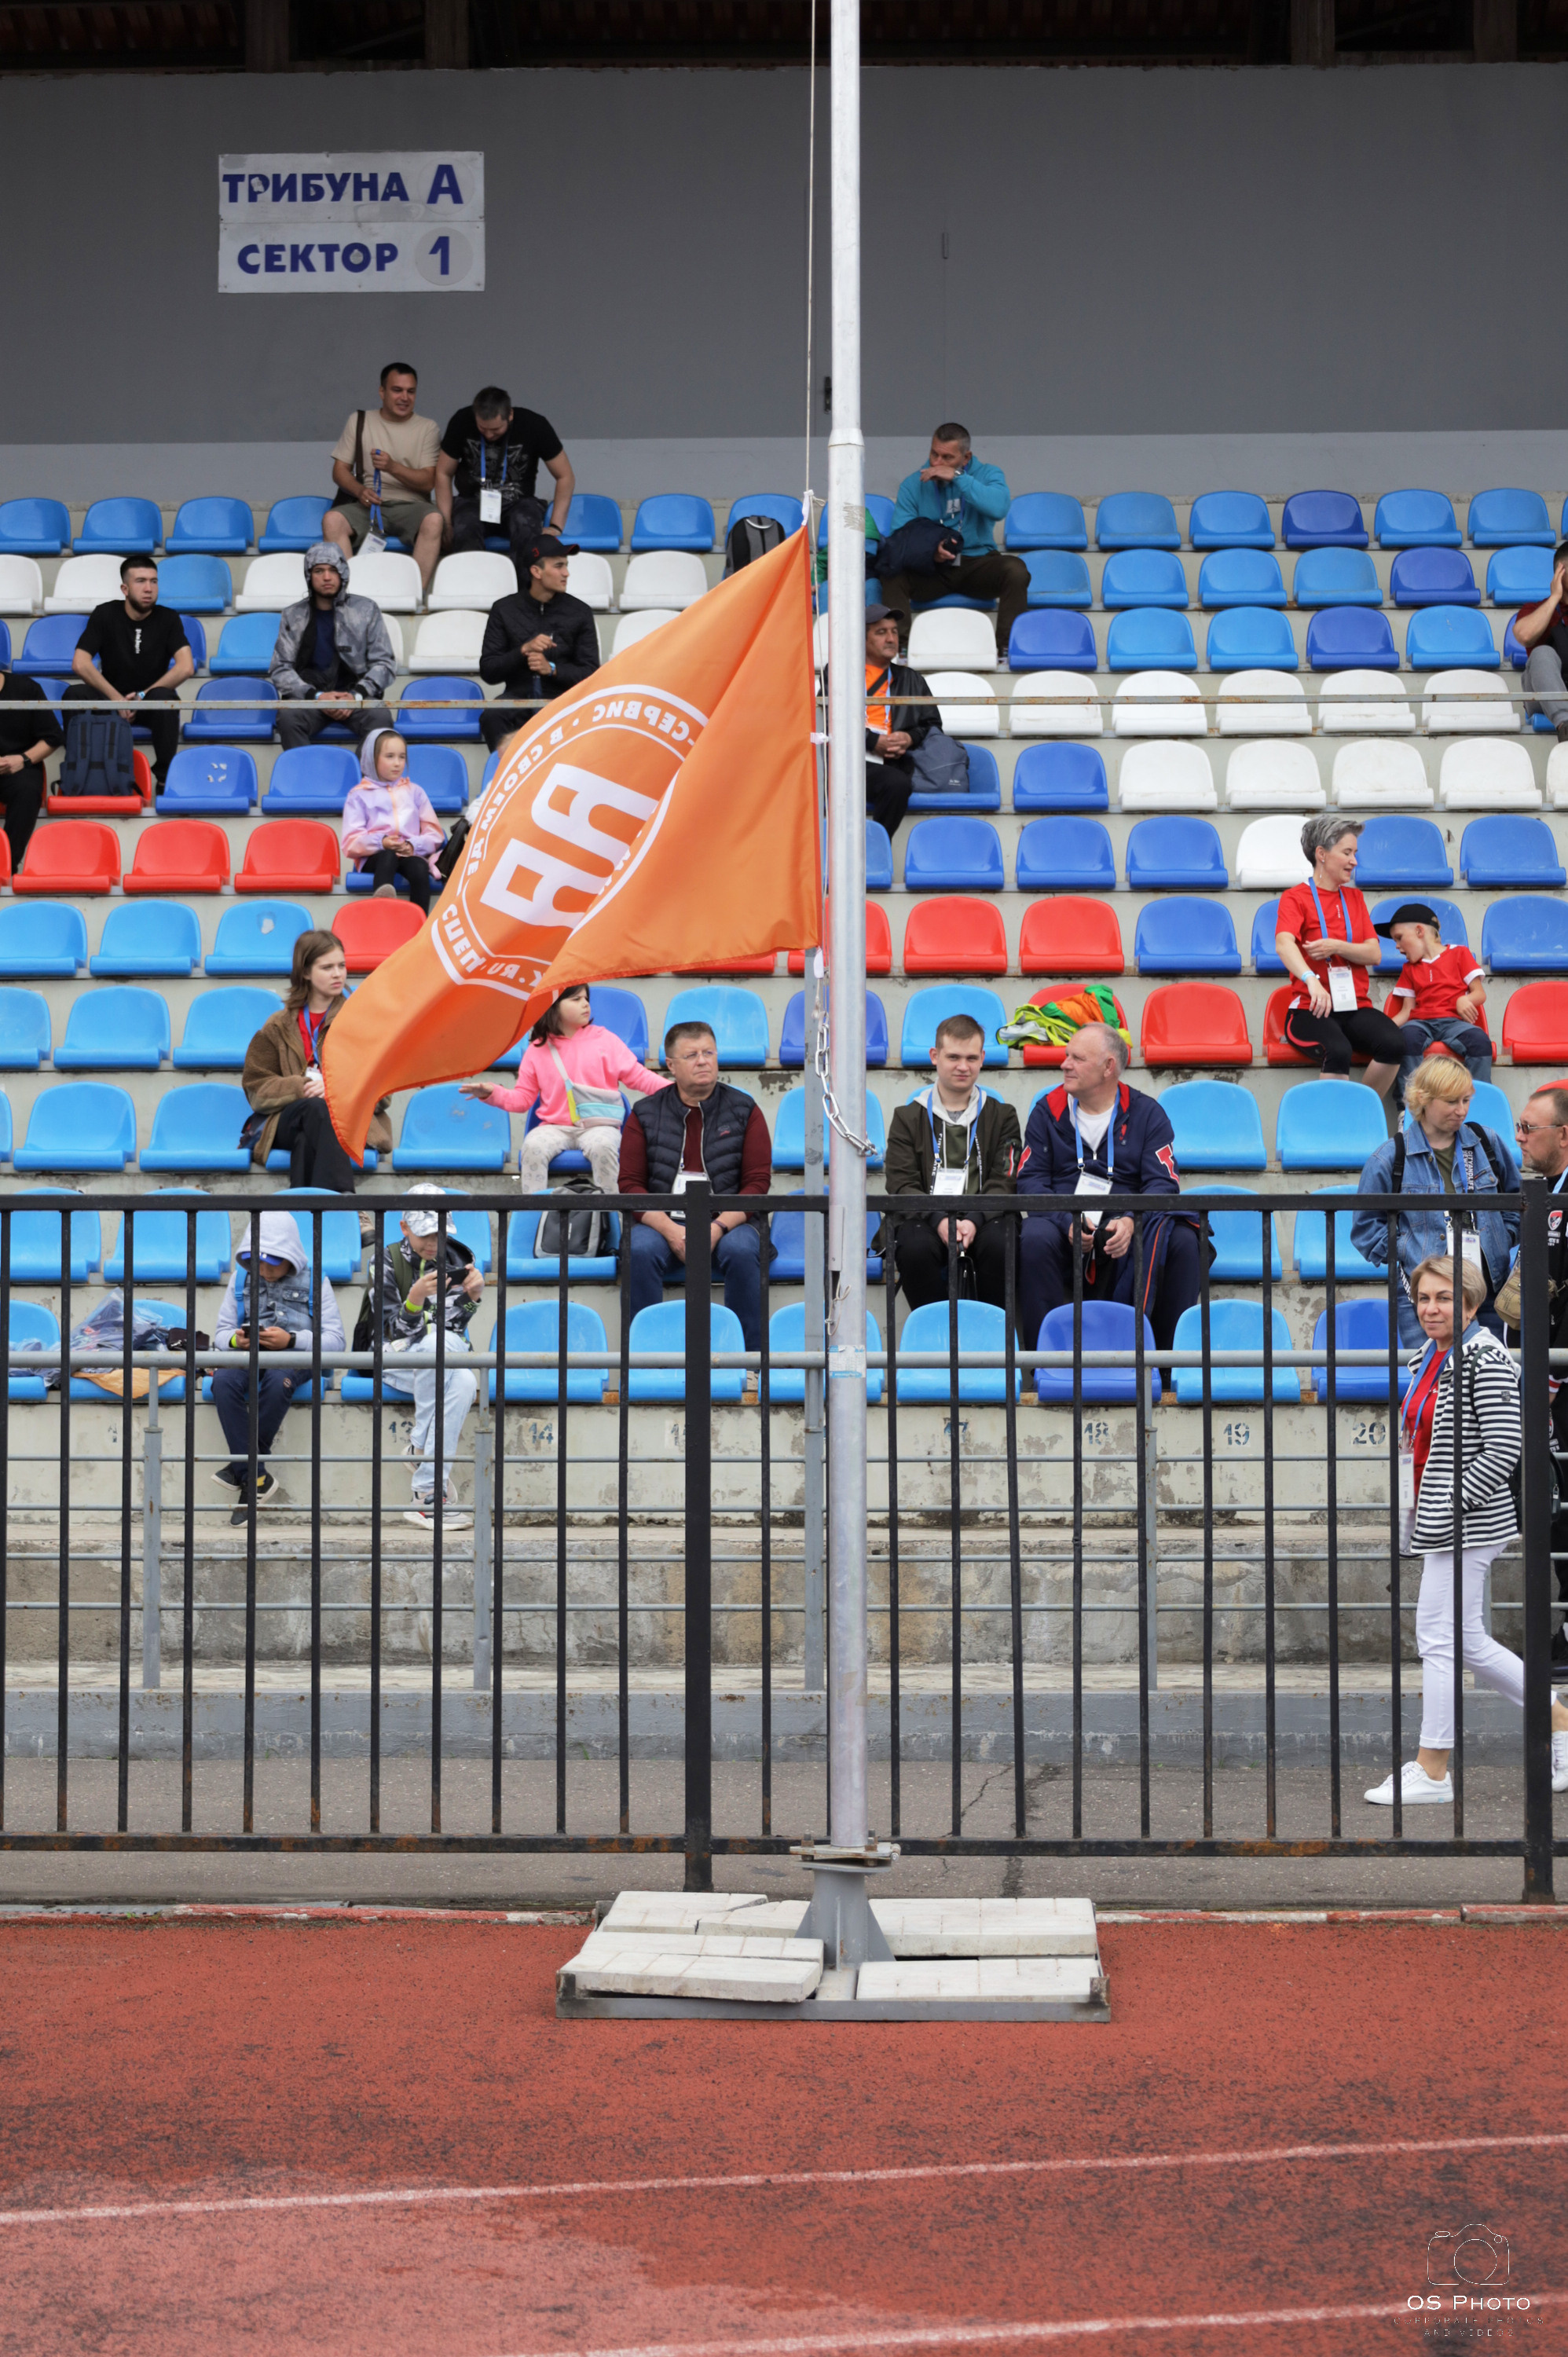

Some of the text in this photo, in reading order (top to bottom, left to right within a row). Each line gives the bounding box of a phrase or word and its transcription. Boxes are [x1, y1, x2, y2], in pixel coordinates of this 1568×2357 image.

[222, 163, 464, 204] ТРИБУНА А
[237, 236, 449, 275] СЕКТОР 1
[529, 1421, 554, 1444] 14
[1084, 1421, 1109, 1445] 18
[1223, 1422, 1250, 1446] 19
[1352, 1421, 1386, 1445] 20
